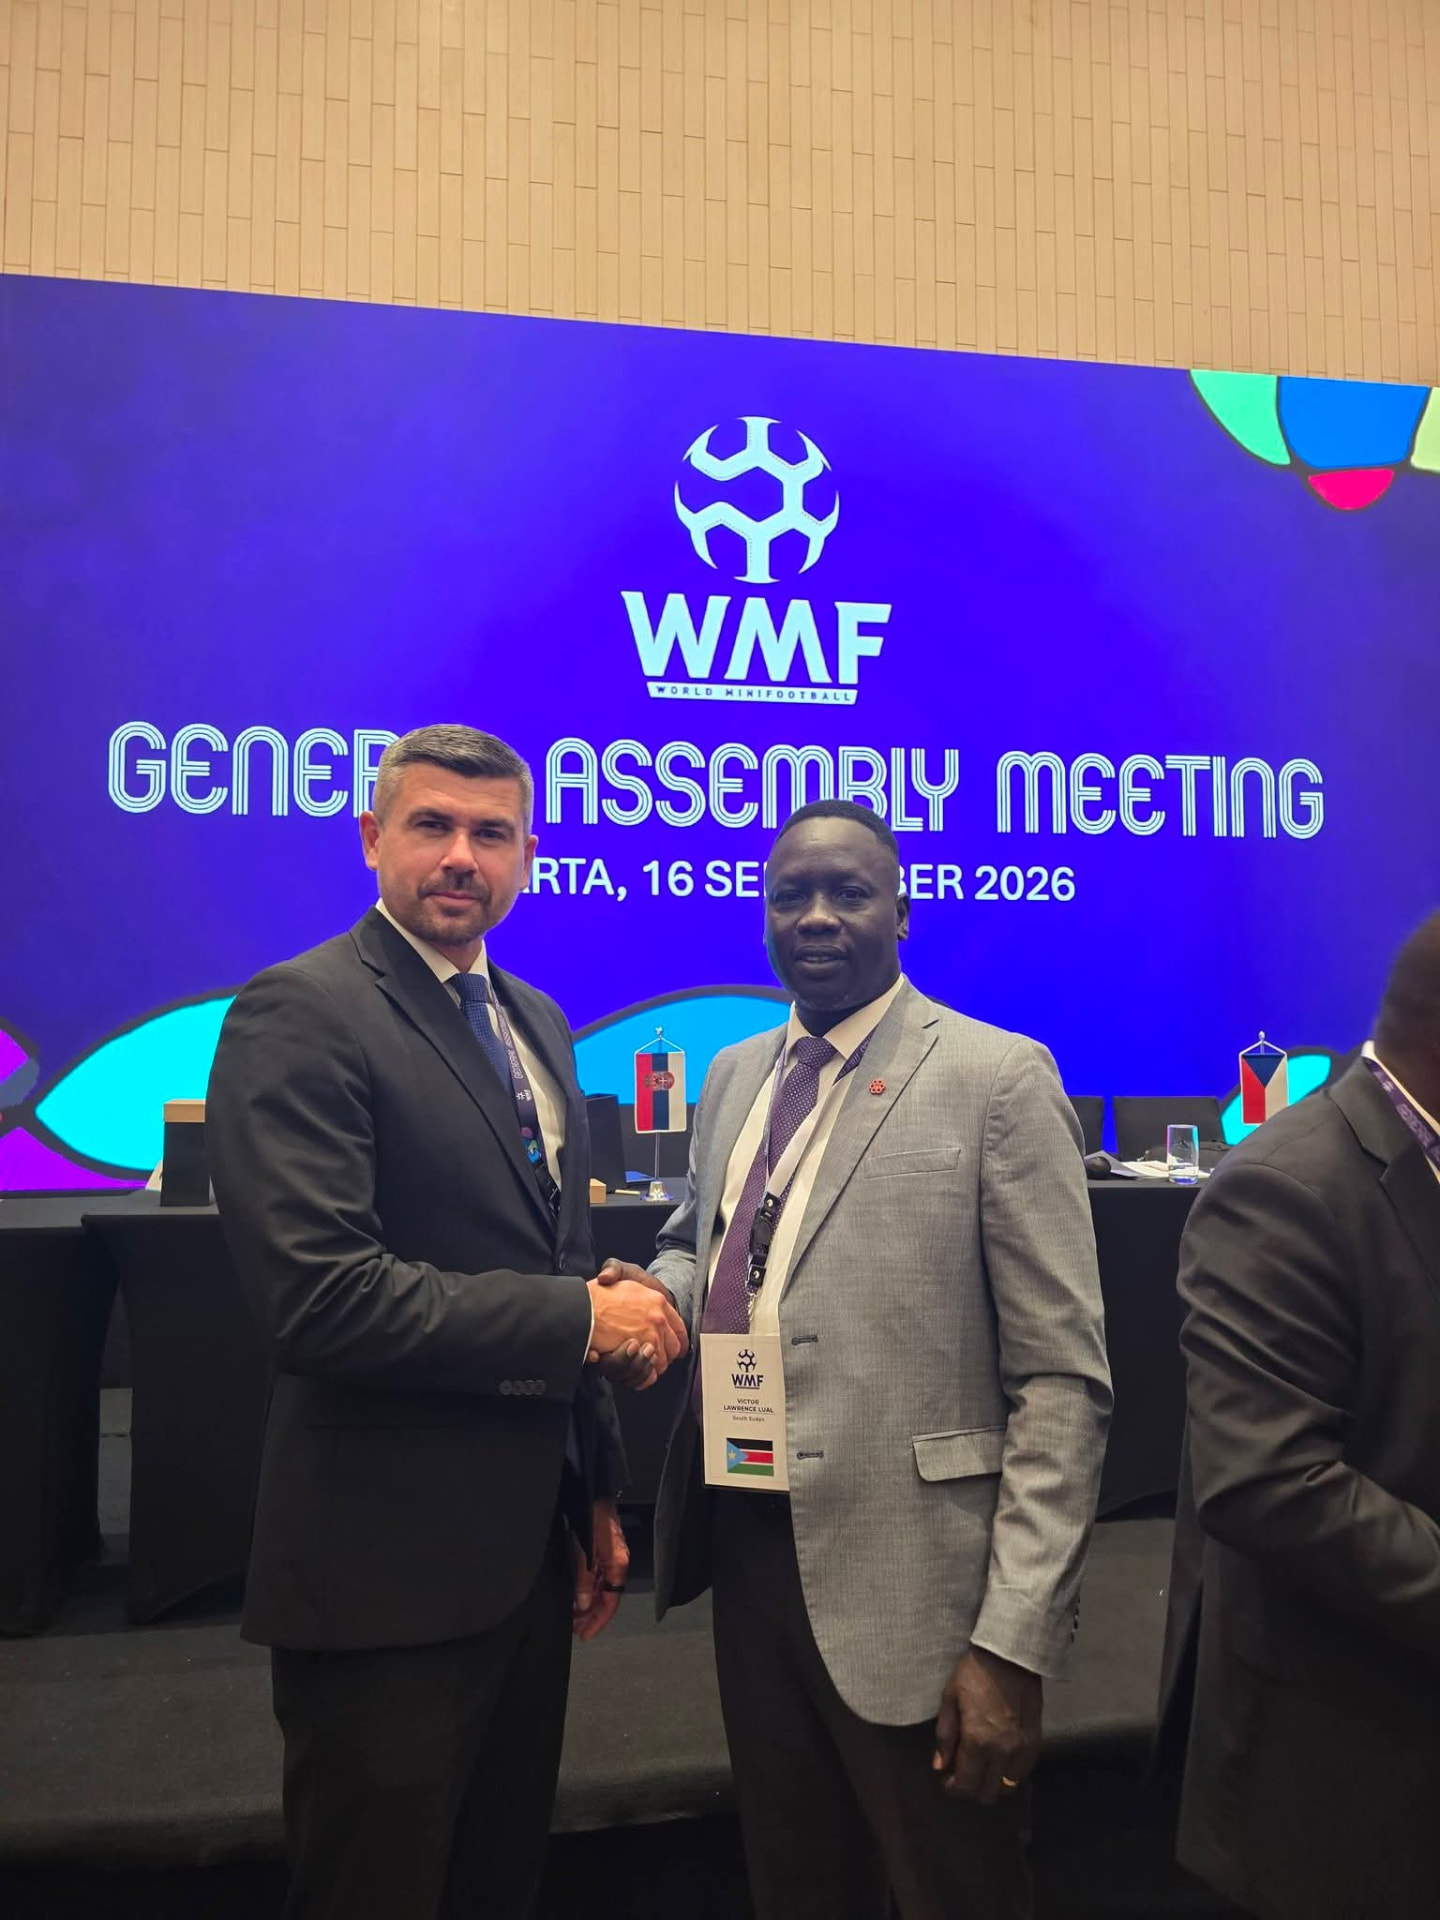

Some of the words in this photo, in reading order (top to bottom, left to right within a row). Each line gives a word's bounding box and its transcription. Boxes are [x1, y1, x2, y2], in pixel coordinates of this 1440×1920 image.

[620, 591, 892, 684] WMF
[656, 686, 713, 696] WORLD
[725, 689, 850, 701] MINIFOOTBALL
[108, 721, 401, 818] GENER
[546, 737, 959, 832] ASSEMBLY
[996, 750, 1325, 839] MEETING
[643, 860, 692, 897] 16
[974, 865, 1076, 902] 2026
[731, 1374, 763, 1386] WMF
